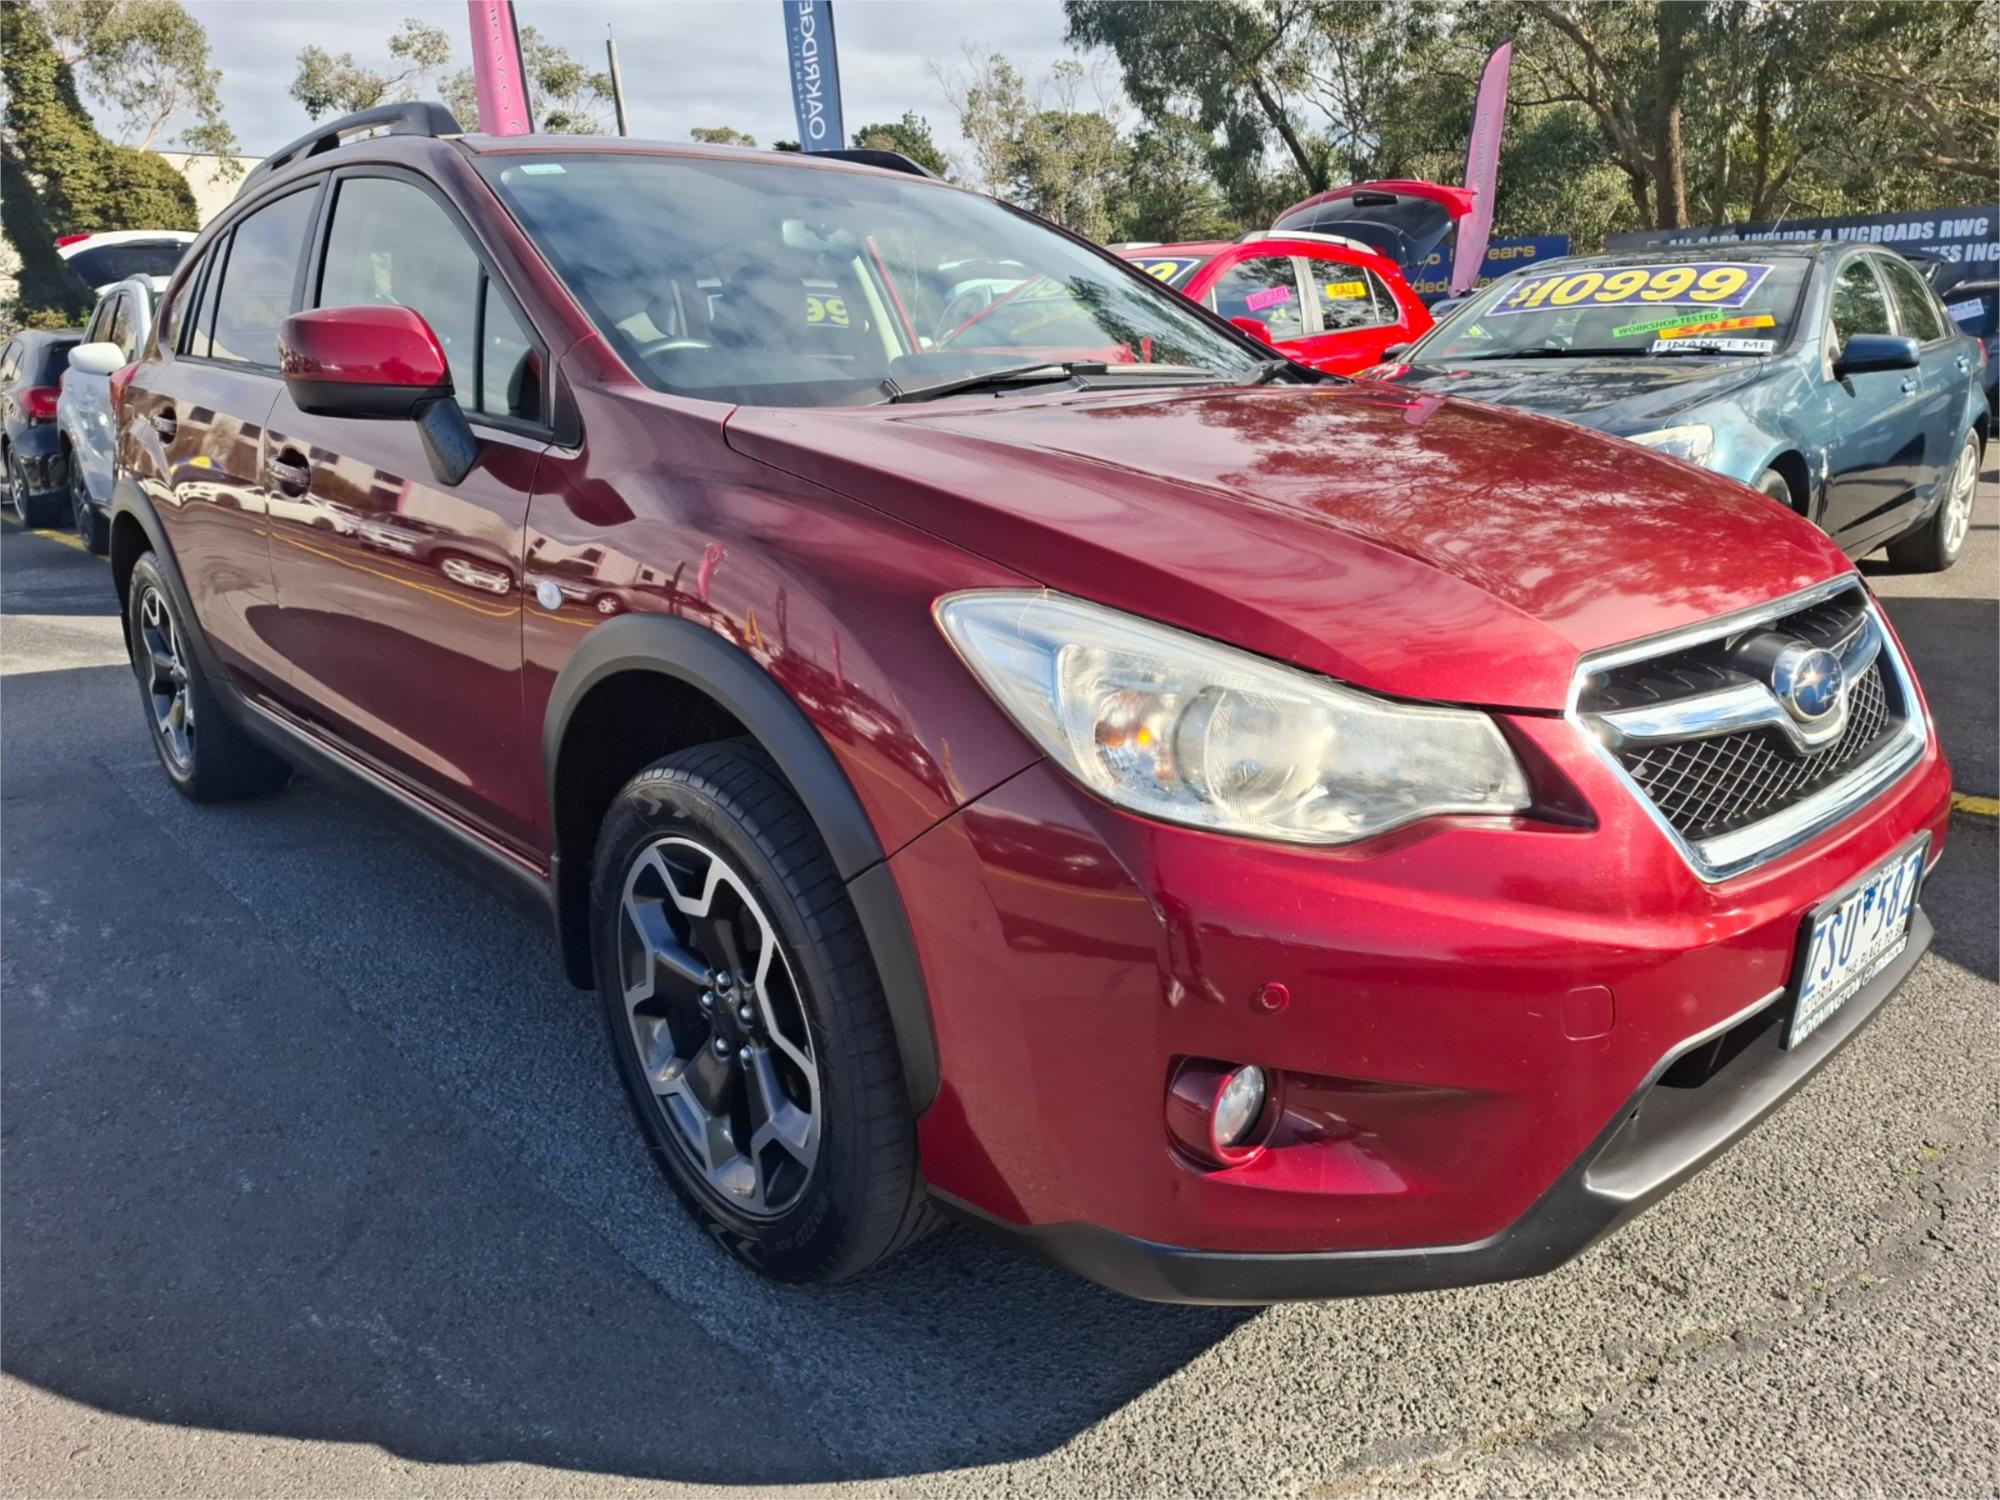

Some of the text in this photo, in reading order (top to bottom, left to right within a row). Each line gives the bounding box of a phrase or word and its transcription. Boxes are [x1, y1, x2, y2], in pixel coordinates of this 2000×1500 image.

[1837, 221, 1935, 243] VICROADS
[1939, 217, 1989, 238] RWC
[1334, 283, 1358, 296] SALE
[1508, 267, 1749, 308] $10999
[1618, 312, 1718, 336] WORKSHOP TESTED
[1677, 318, 1756, 336] SALE
[1656, 339, 1771, 350] FINANCE ME
